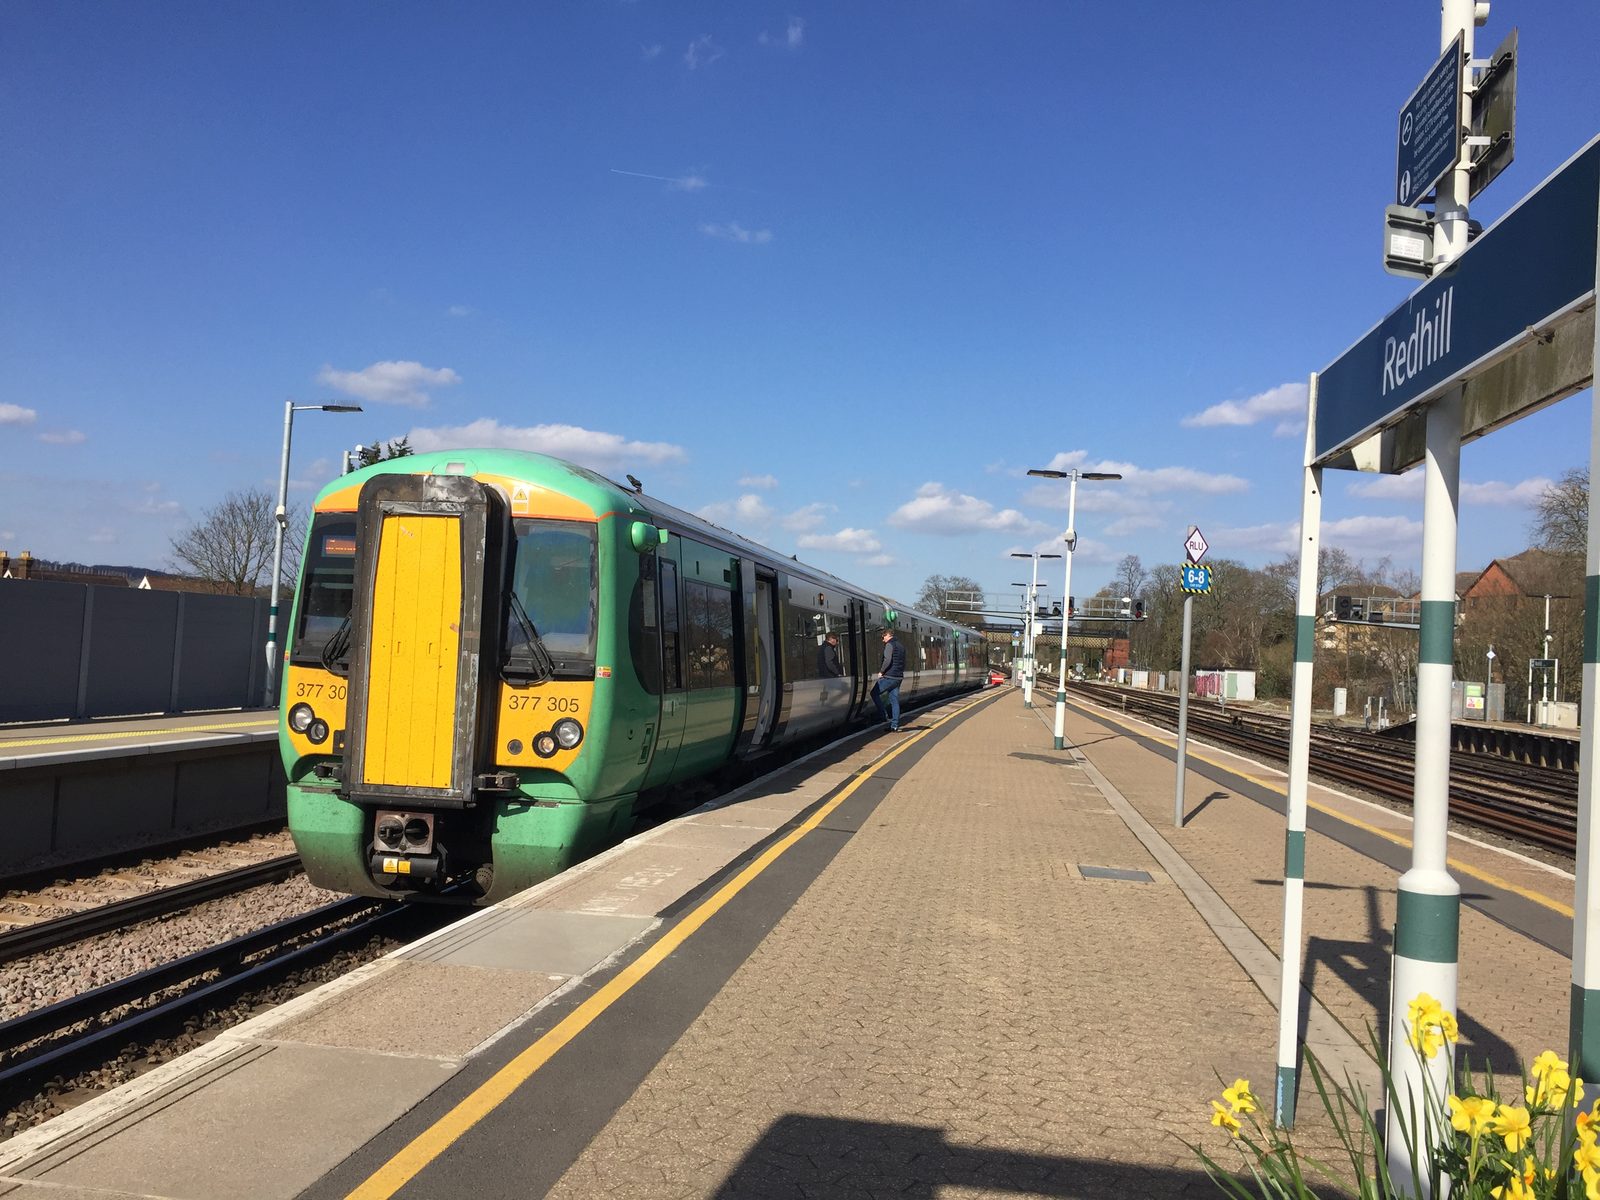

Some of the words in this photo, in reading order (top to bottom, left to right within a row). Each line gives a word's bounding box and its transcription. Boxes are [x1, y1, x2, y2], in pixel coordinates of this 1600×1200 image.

[1383, 286, 1453, 396] Redhill
[1189, 540, 1204, 550] RLU
[1188, 570, 1204, 584] 6-8
[296, 683, 324, 698] 377
[328, 685, 346, 700] 30
[509, 696, 542, 711] 377
[547, 697, 580, 713] 305
